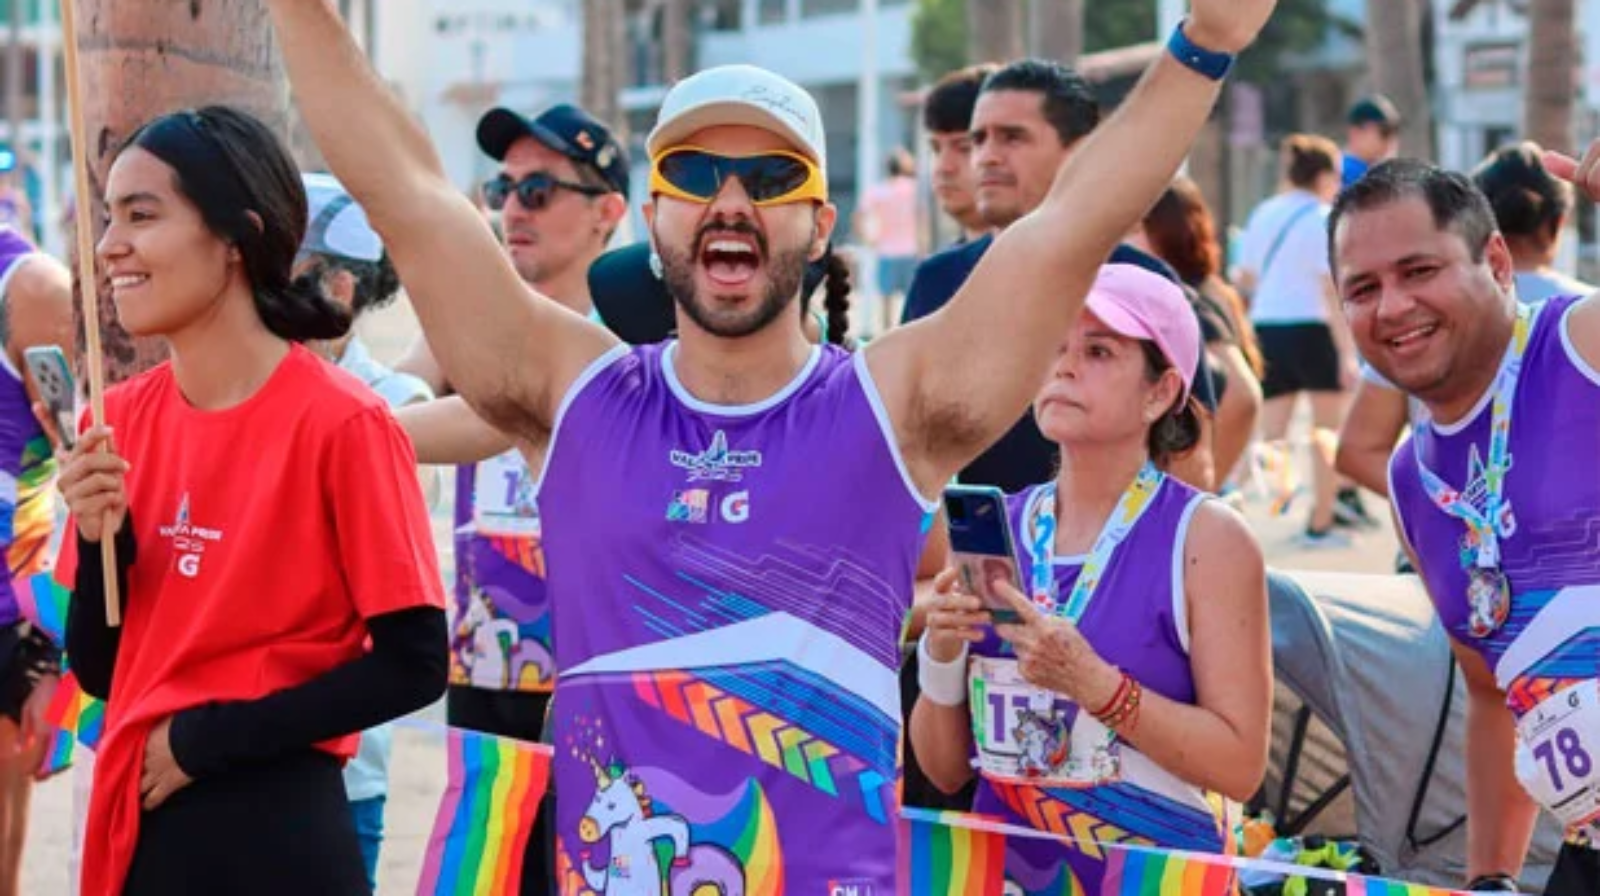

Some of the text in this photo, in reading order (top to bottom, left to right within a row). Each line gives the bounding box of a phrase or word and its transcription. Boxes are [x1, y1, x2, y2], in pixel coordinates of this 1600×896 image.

[721, 489, 750, 523] G
[178, 553, 201, 578] G
[1533, 727, 1592, 792] 78
